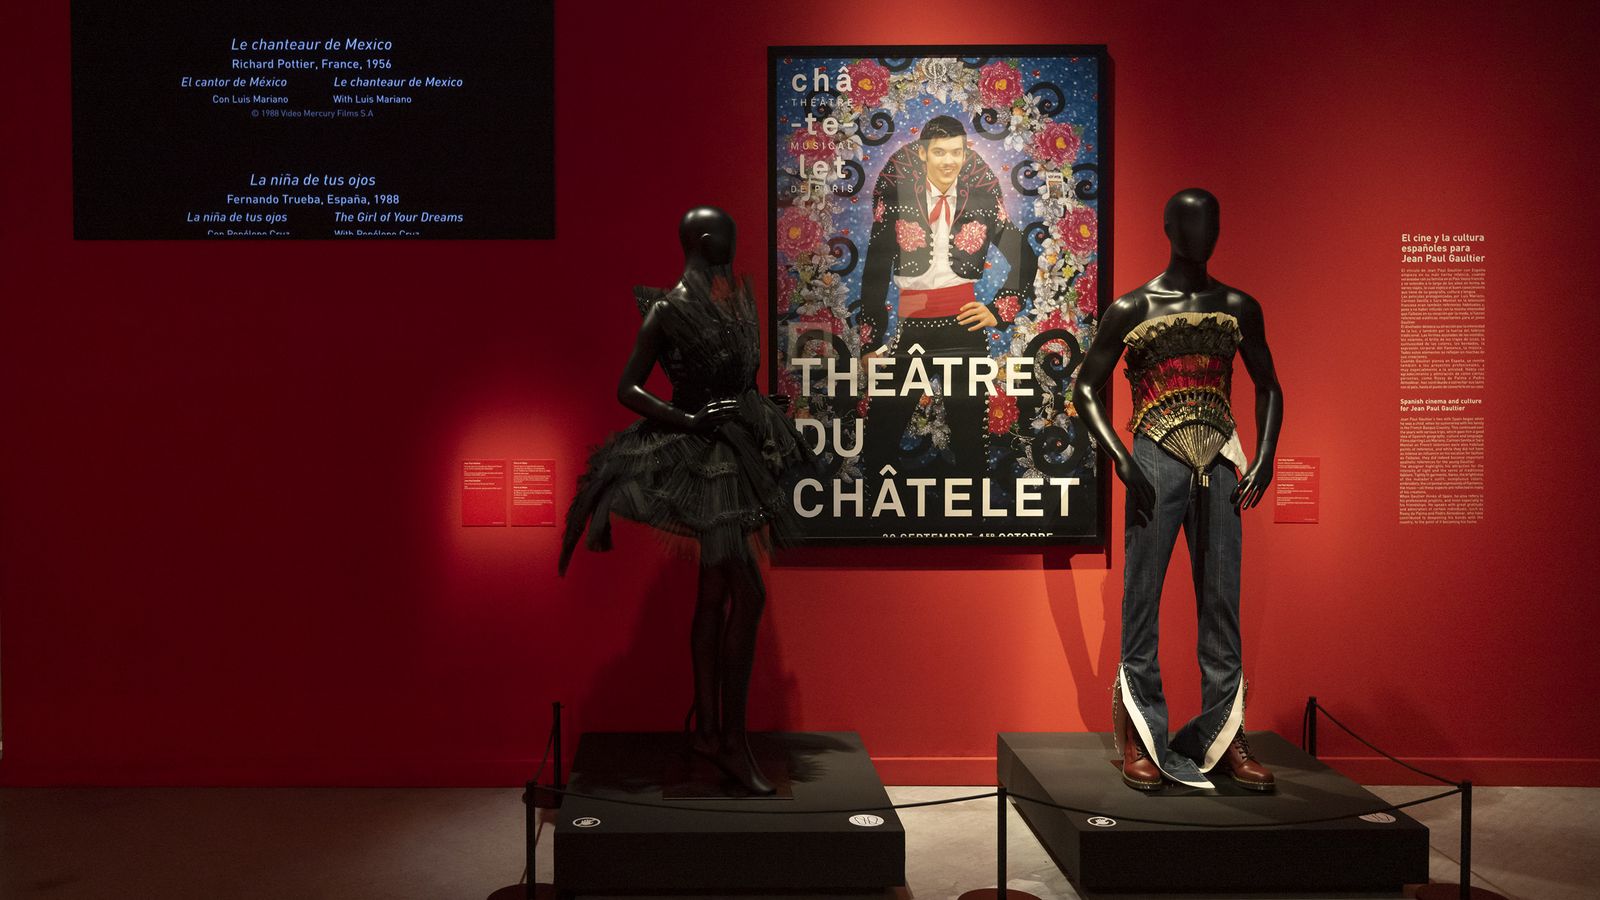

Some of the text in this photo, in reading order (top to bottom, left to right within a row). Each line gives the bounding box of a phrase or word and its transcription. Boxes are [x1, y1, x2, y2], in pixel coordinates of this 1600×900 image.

[231, 37, 393, 51] Le chanteaur de Mexico
[232, 58, 392, 70] Richard Pottier, France, 1956
[181, 76, 288, 88] El cantor de México
[333, 76, 464, 88] Le chanteaur de Mexico
[791, 65, 853, 93] châ
[212, 94, 289, 104] Con Luis Mariano
[332, 94, 412, 104] With Luis Mariano
[791, 96, 854, 107] THÉÂTRE
[250, 108, 375, 120] © 1988 Video Mercury Films S.A
[790, 142, 854, 150] MUSICAL
[799, 154, 846, 179] let
[250, 173, 376, 189] La niña de tus ojos
[790, 185, 854, 194] DE PARIS
[226, 193, 400, 207] Fernando Trueba, España, 1988
[186, 211, 288, 225] La niña de tus ojos
[335, 211, 464, 223] The Girl of Your Dreams
[1401, 233, 1485, 244] El cine y la cultura
[1401, 243, 1471, 254] españoles para
[1401, 253, 1486, 263] Jean Paul Gaultier
[791, 342, 1035, 397] THÉÂTRE
[1399, 398, 1424, 406] Spanish
[795, 418, 864, 458] DU
[793, 464, 1080, 520] CHÂTELET
